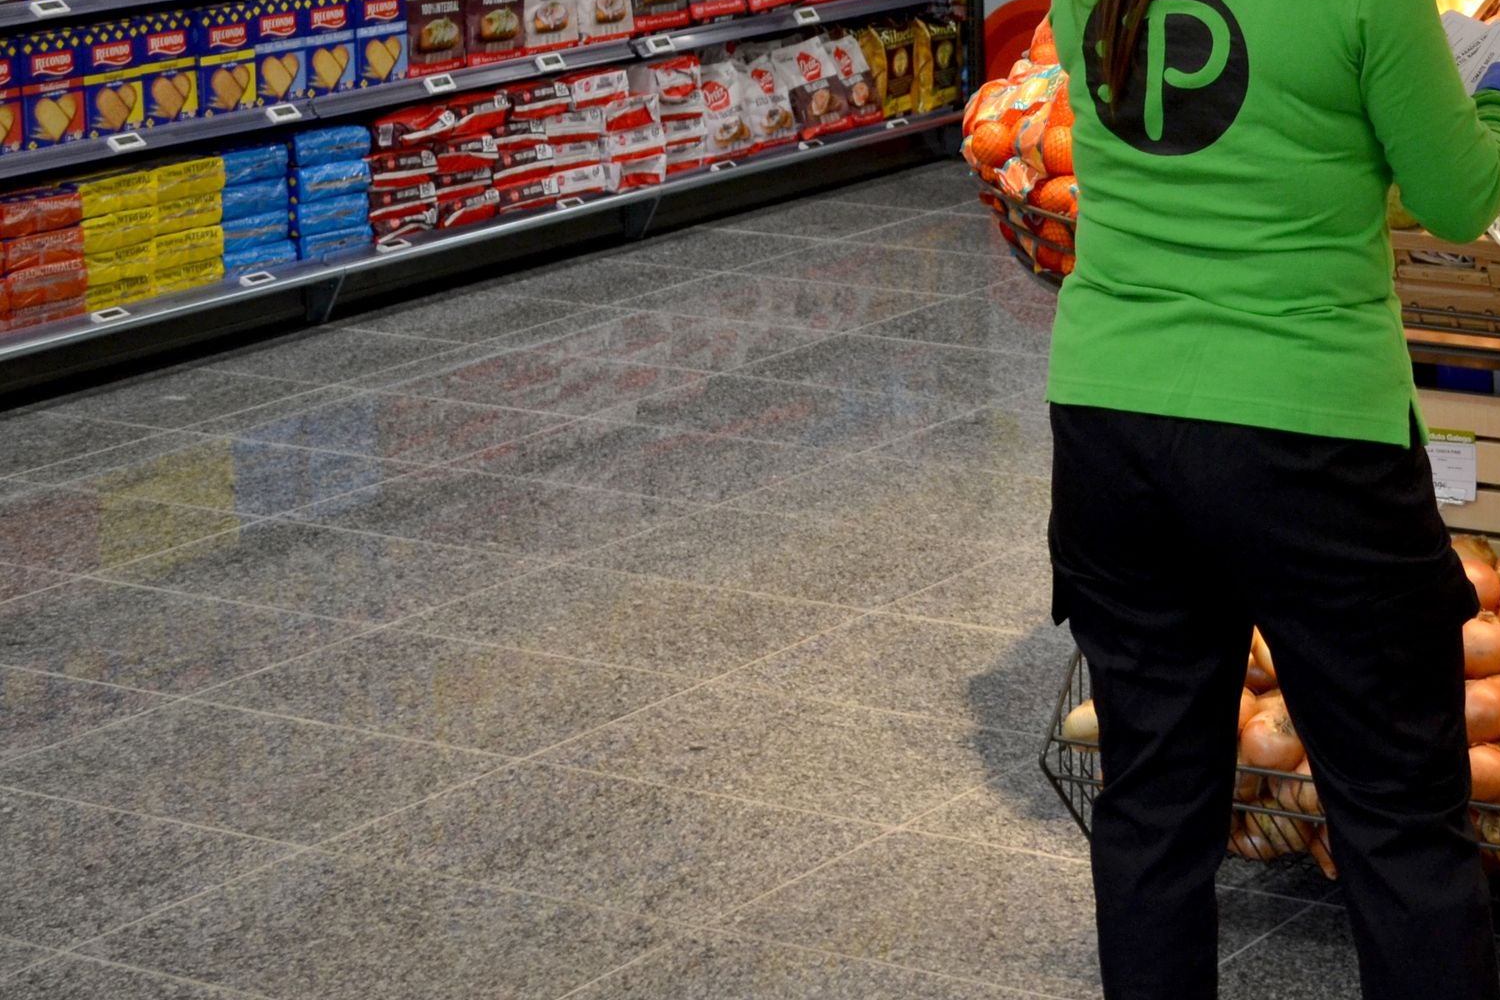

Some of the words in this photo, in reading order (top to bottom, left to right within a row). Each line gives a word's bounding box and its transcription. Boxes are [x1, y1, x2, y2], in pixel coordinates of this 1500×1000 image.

[367, 1, 397, 16] RECONDO
[262, 15, 294, 31] RECONDO
[313, 9, 344, 25] RECONDO
[150, 34, 184, 50] RECONDO
[212, 27, 244, 43] RECONDO
[95, 44, 130, 60] RECONDO
[35, 53, 71, 70] RECONDO
[1446, 434, 1473, 443] Galego
